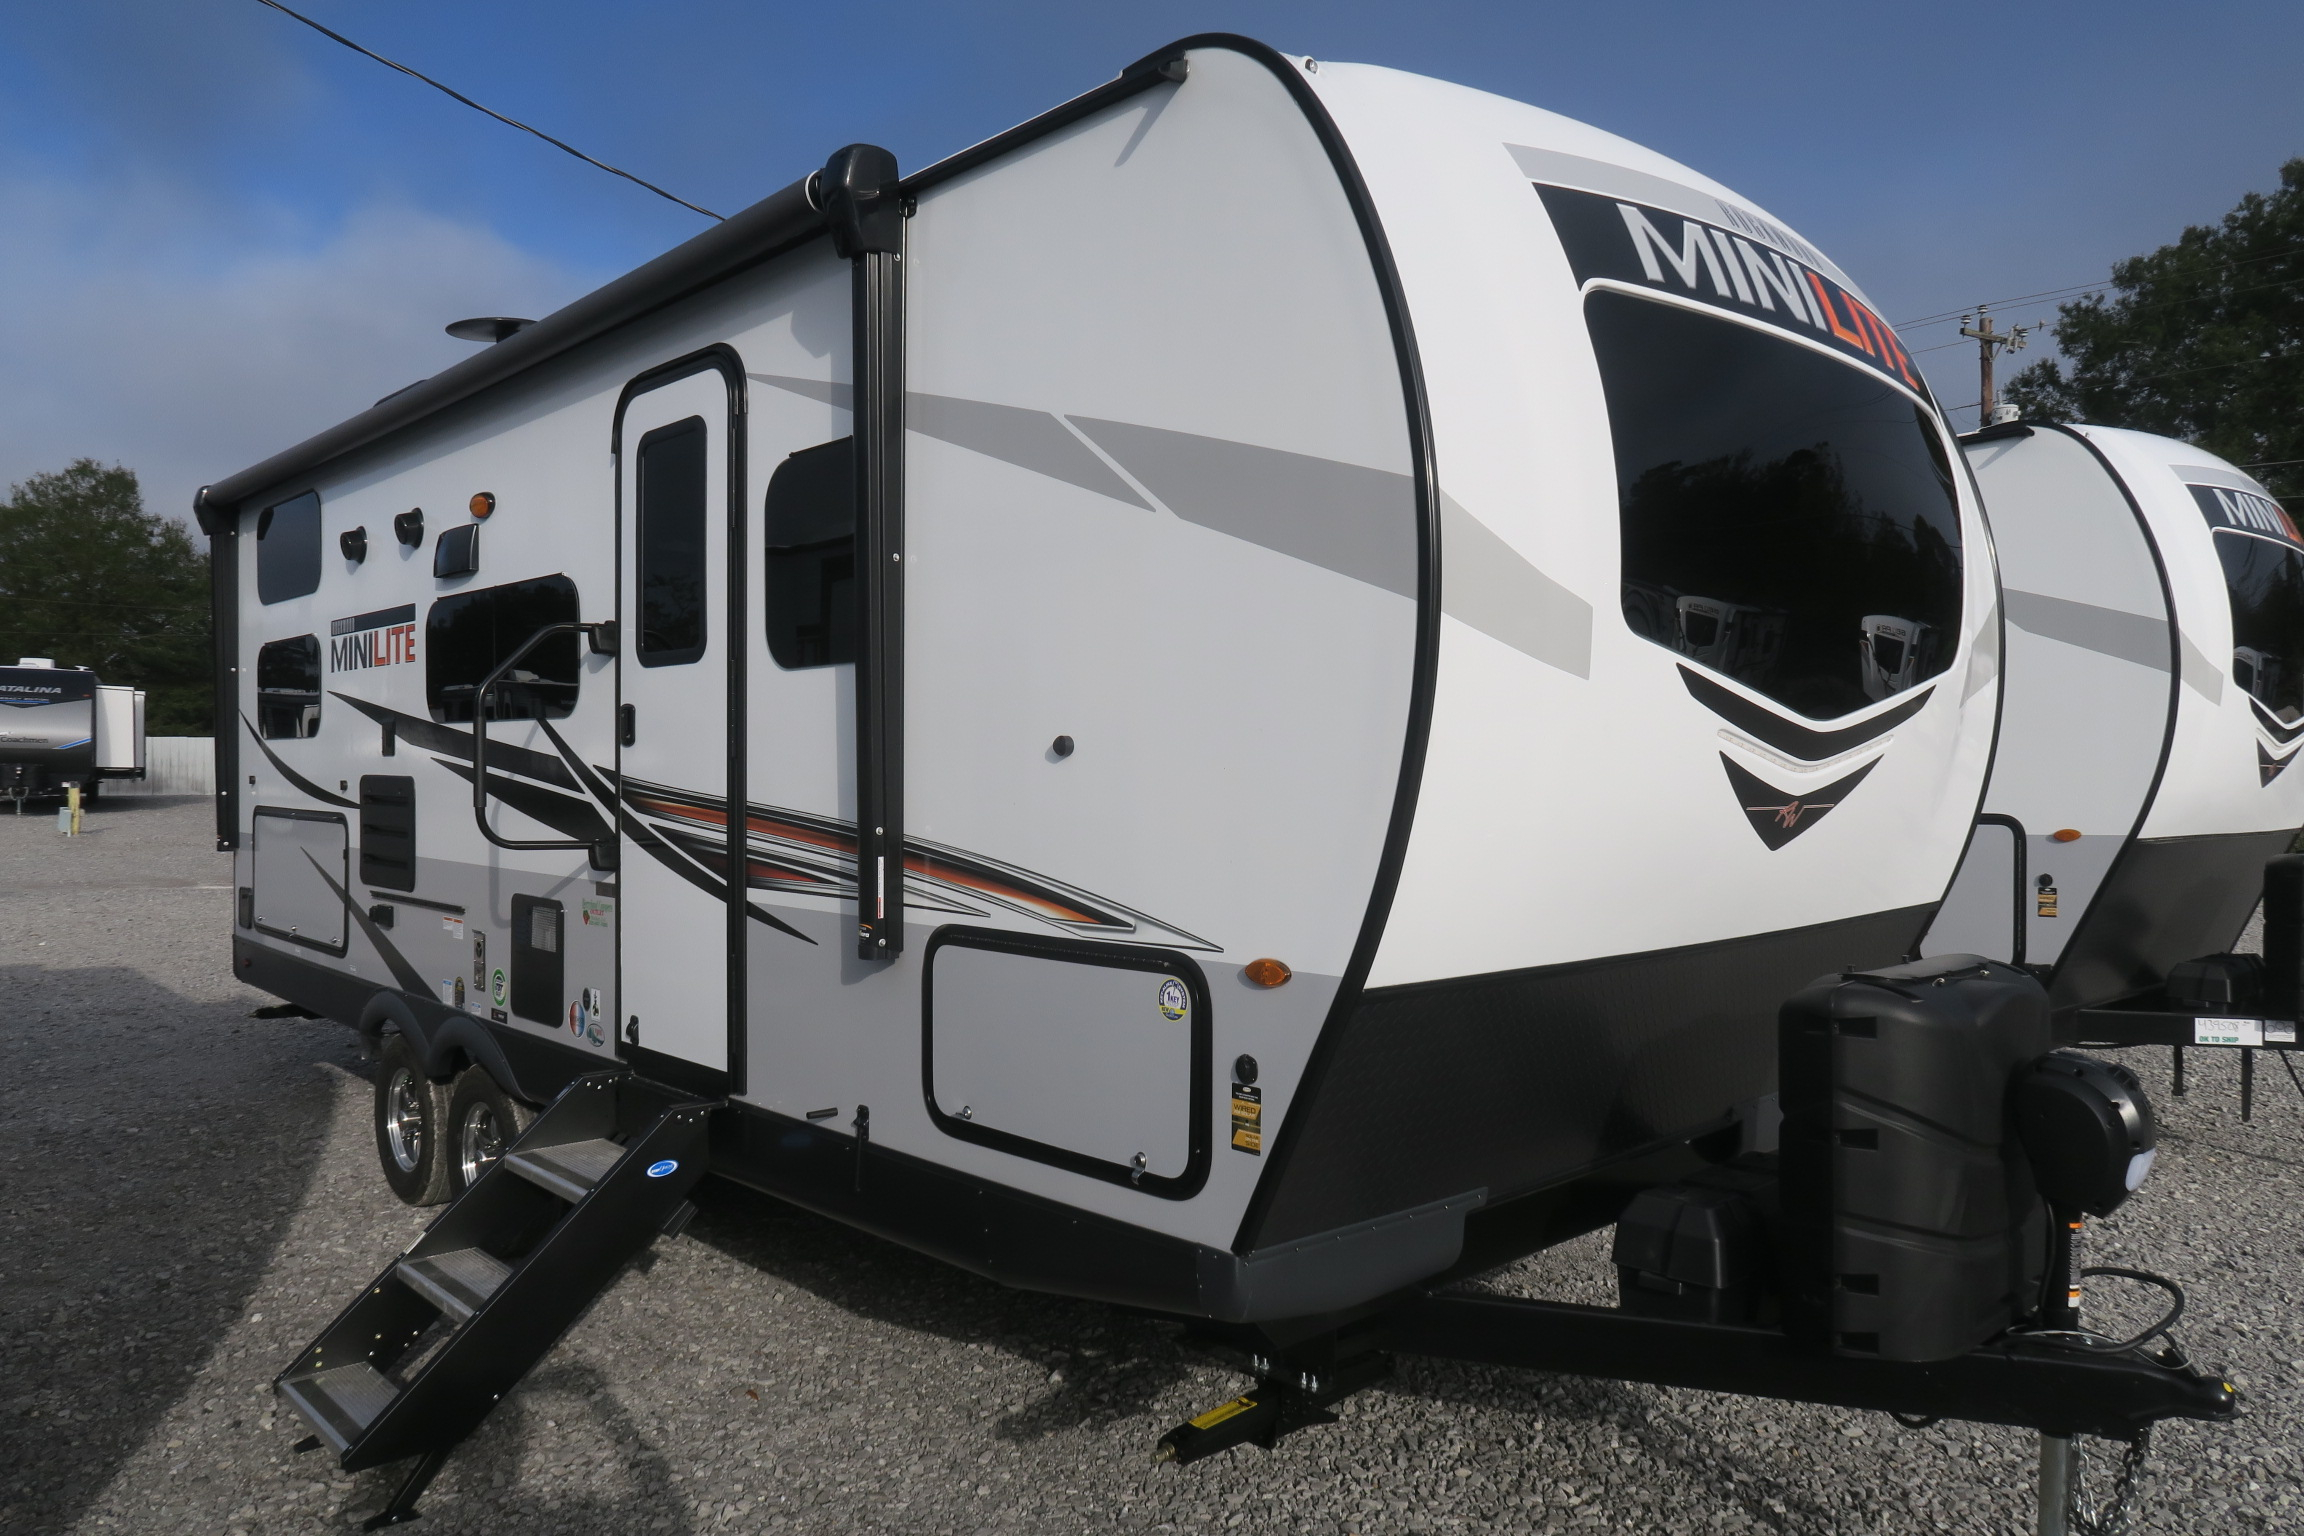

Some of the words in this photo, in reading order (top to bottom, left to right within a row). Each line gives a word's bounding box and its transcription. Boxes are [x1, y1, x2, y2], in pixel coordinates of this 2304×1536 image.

[331, 623, 416, 673] MINILITE
[0, 685, 62, 694] ATALINA
[1233, 1103, 1256, 1114] WIRED
